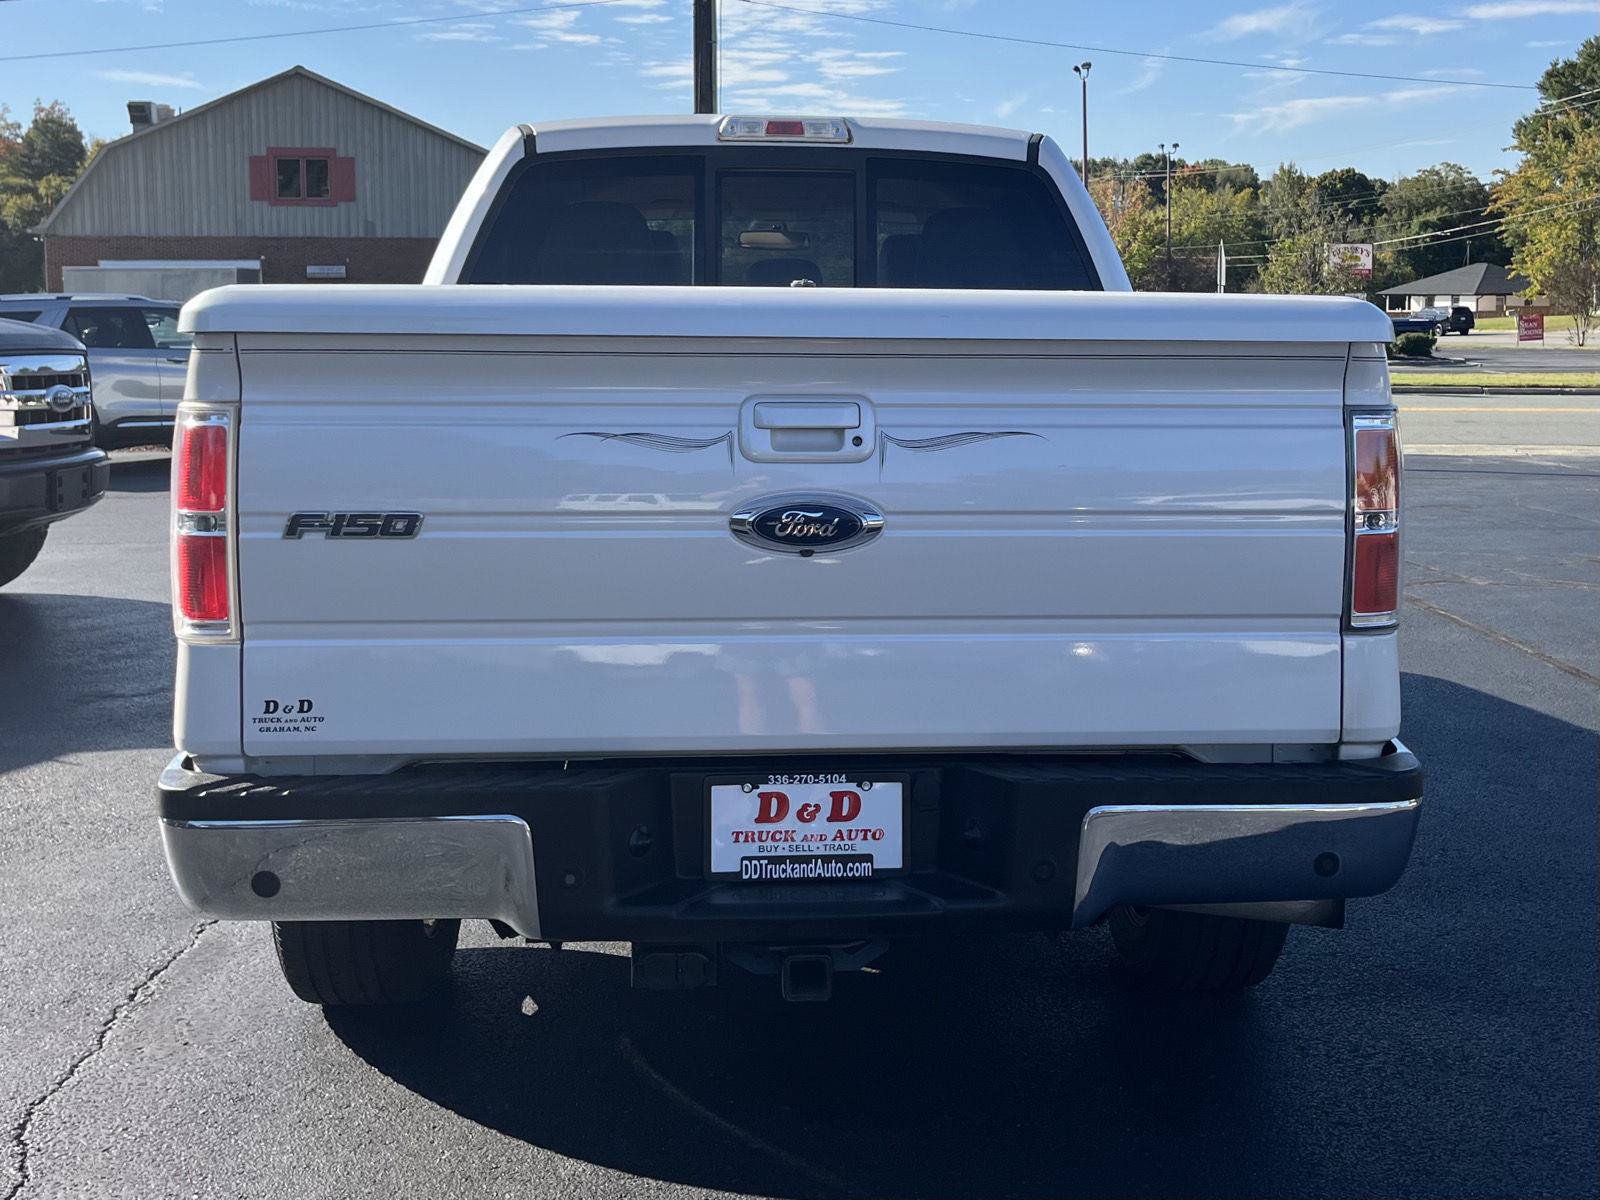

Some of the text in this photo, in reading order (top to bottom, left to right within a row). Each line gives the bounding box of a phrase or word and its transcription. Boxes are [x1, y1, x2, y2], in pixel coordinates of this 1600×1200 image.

[282, 511, 425, 539] F-150
[774, 510, 839, 537] Ford
[263, 699, 313, 714] D & D
[767, 774, 847, 785] 336-270-5104
[754, 790, 862, 824] D & D
[731, 828, 885, 843] TRUCK AND AUTO
[758, 843, 857, 853] BUY SELL TRADE
[741, 858, 872, 880] DDTruckandAuto.com
